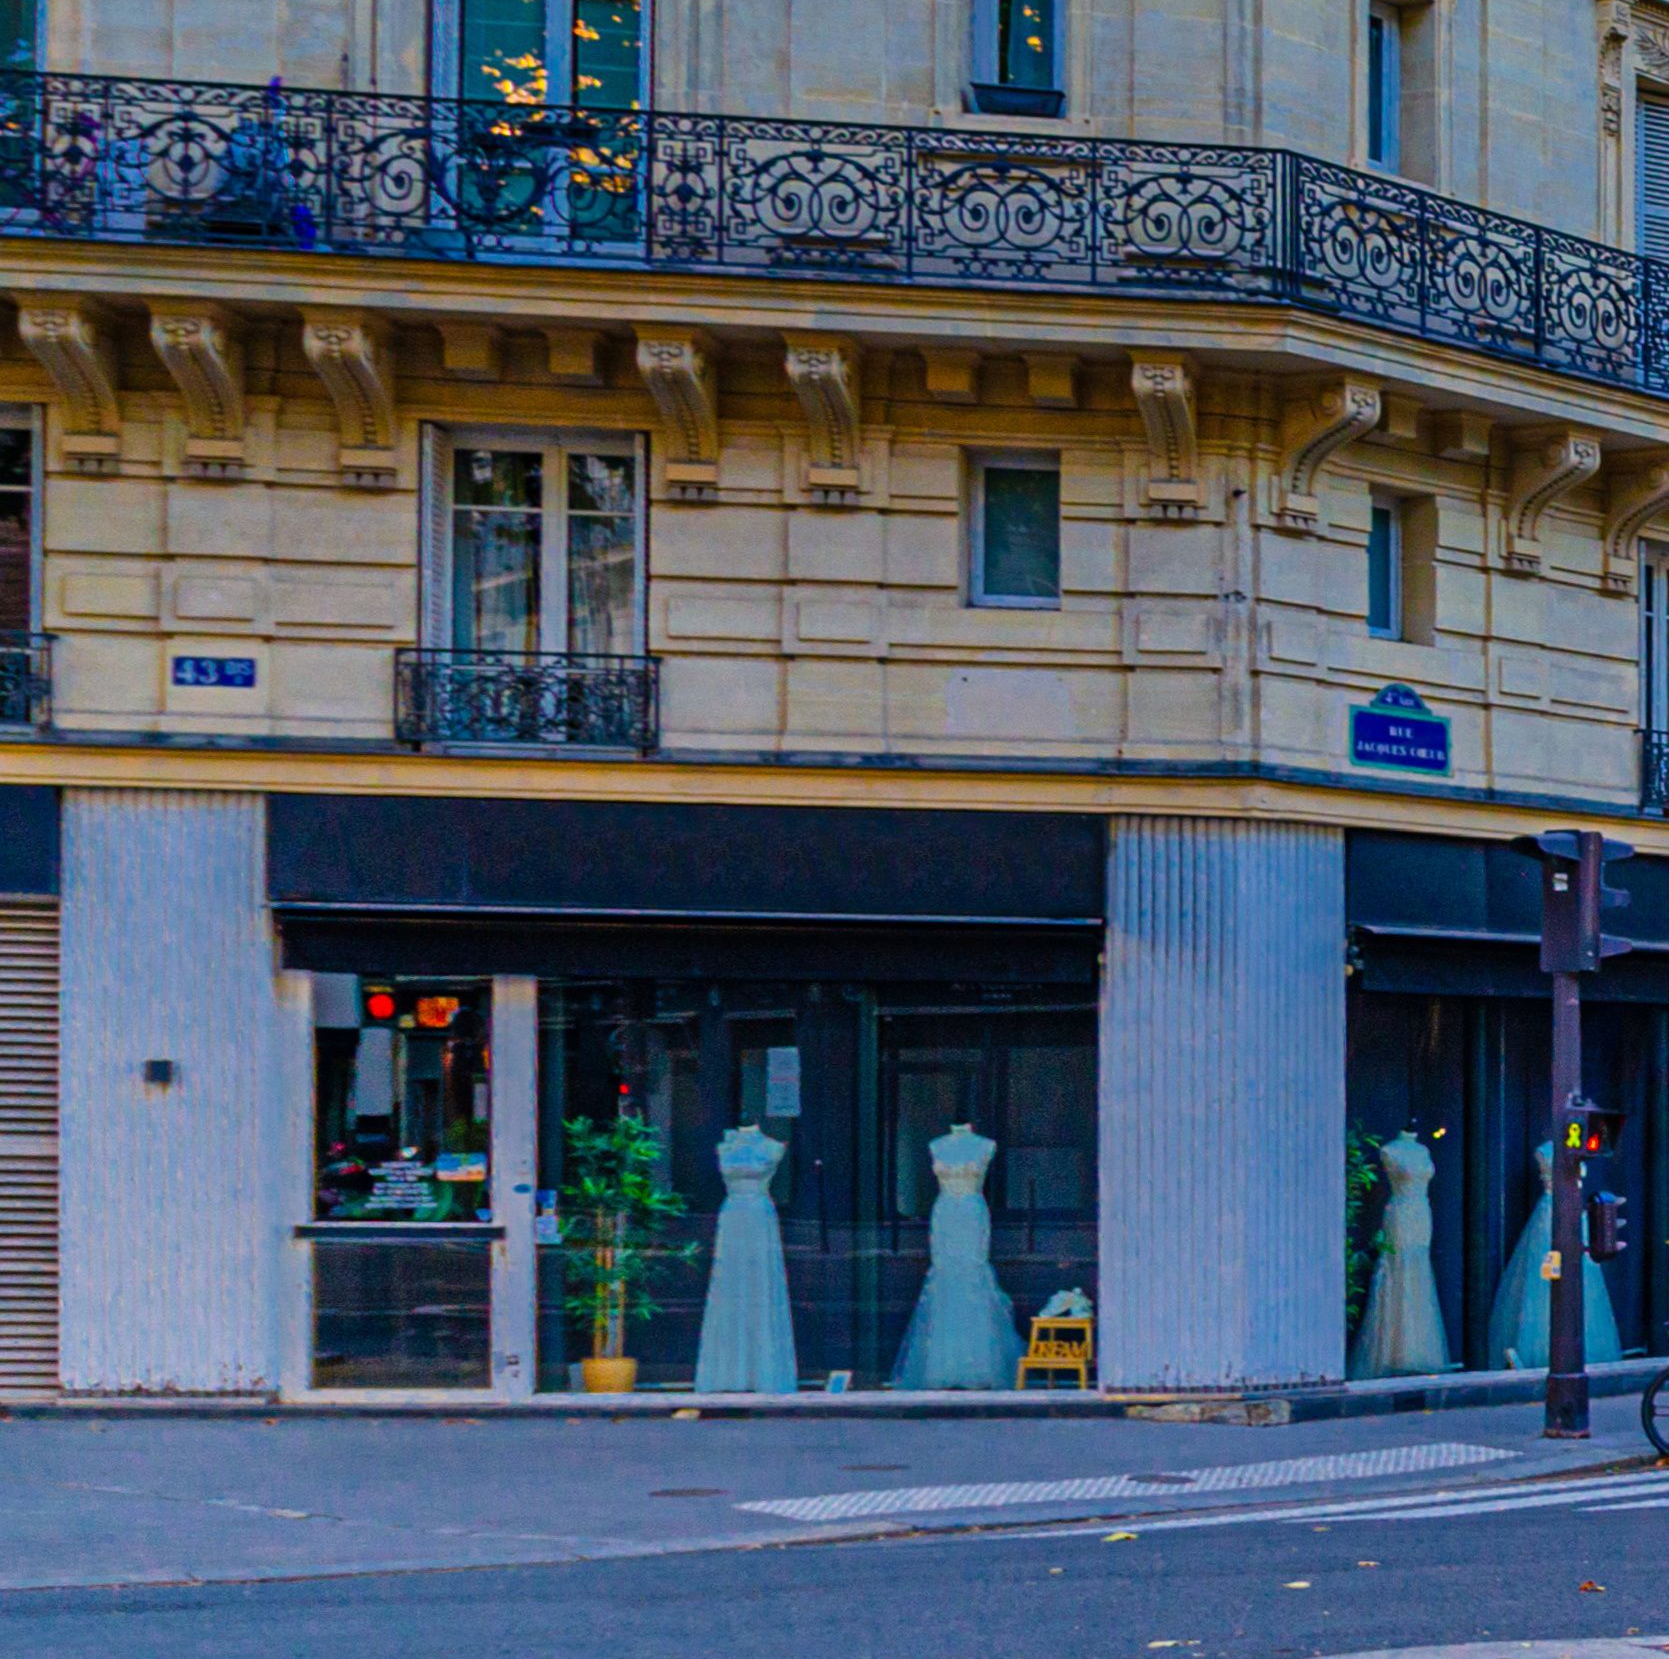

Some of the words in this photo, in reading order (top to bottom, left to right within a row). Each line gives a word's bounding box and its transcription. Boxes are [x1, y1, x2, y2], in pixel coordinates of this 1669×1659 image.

[177, 659, 219, 684] 43
[1389, 726, 1413, 739] RUE
[1357, 740, 1407, 756] JACQUES
